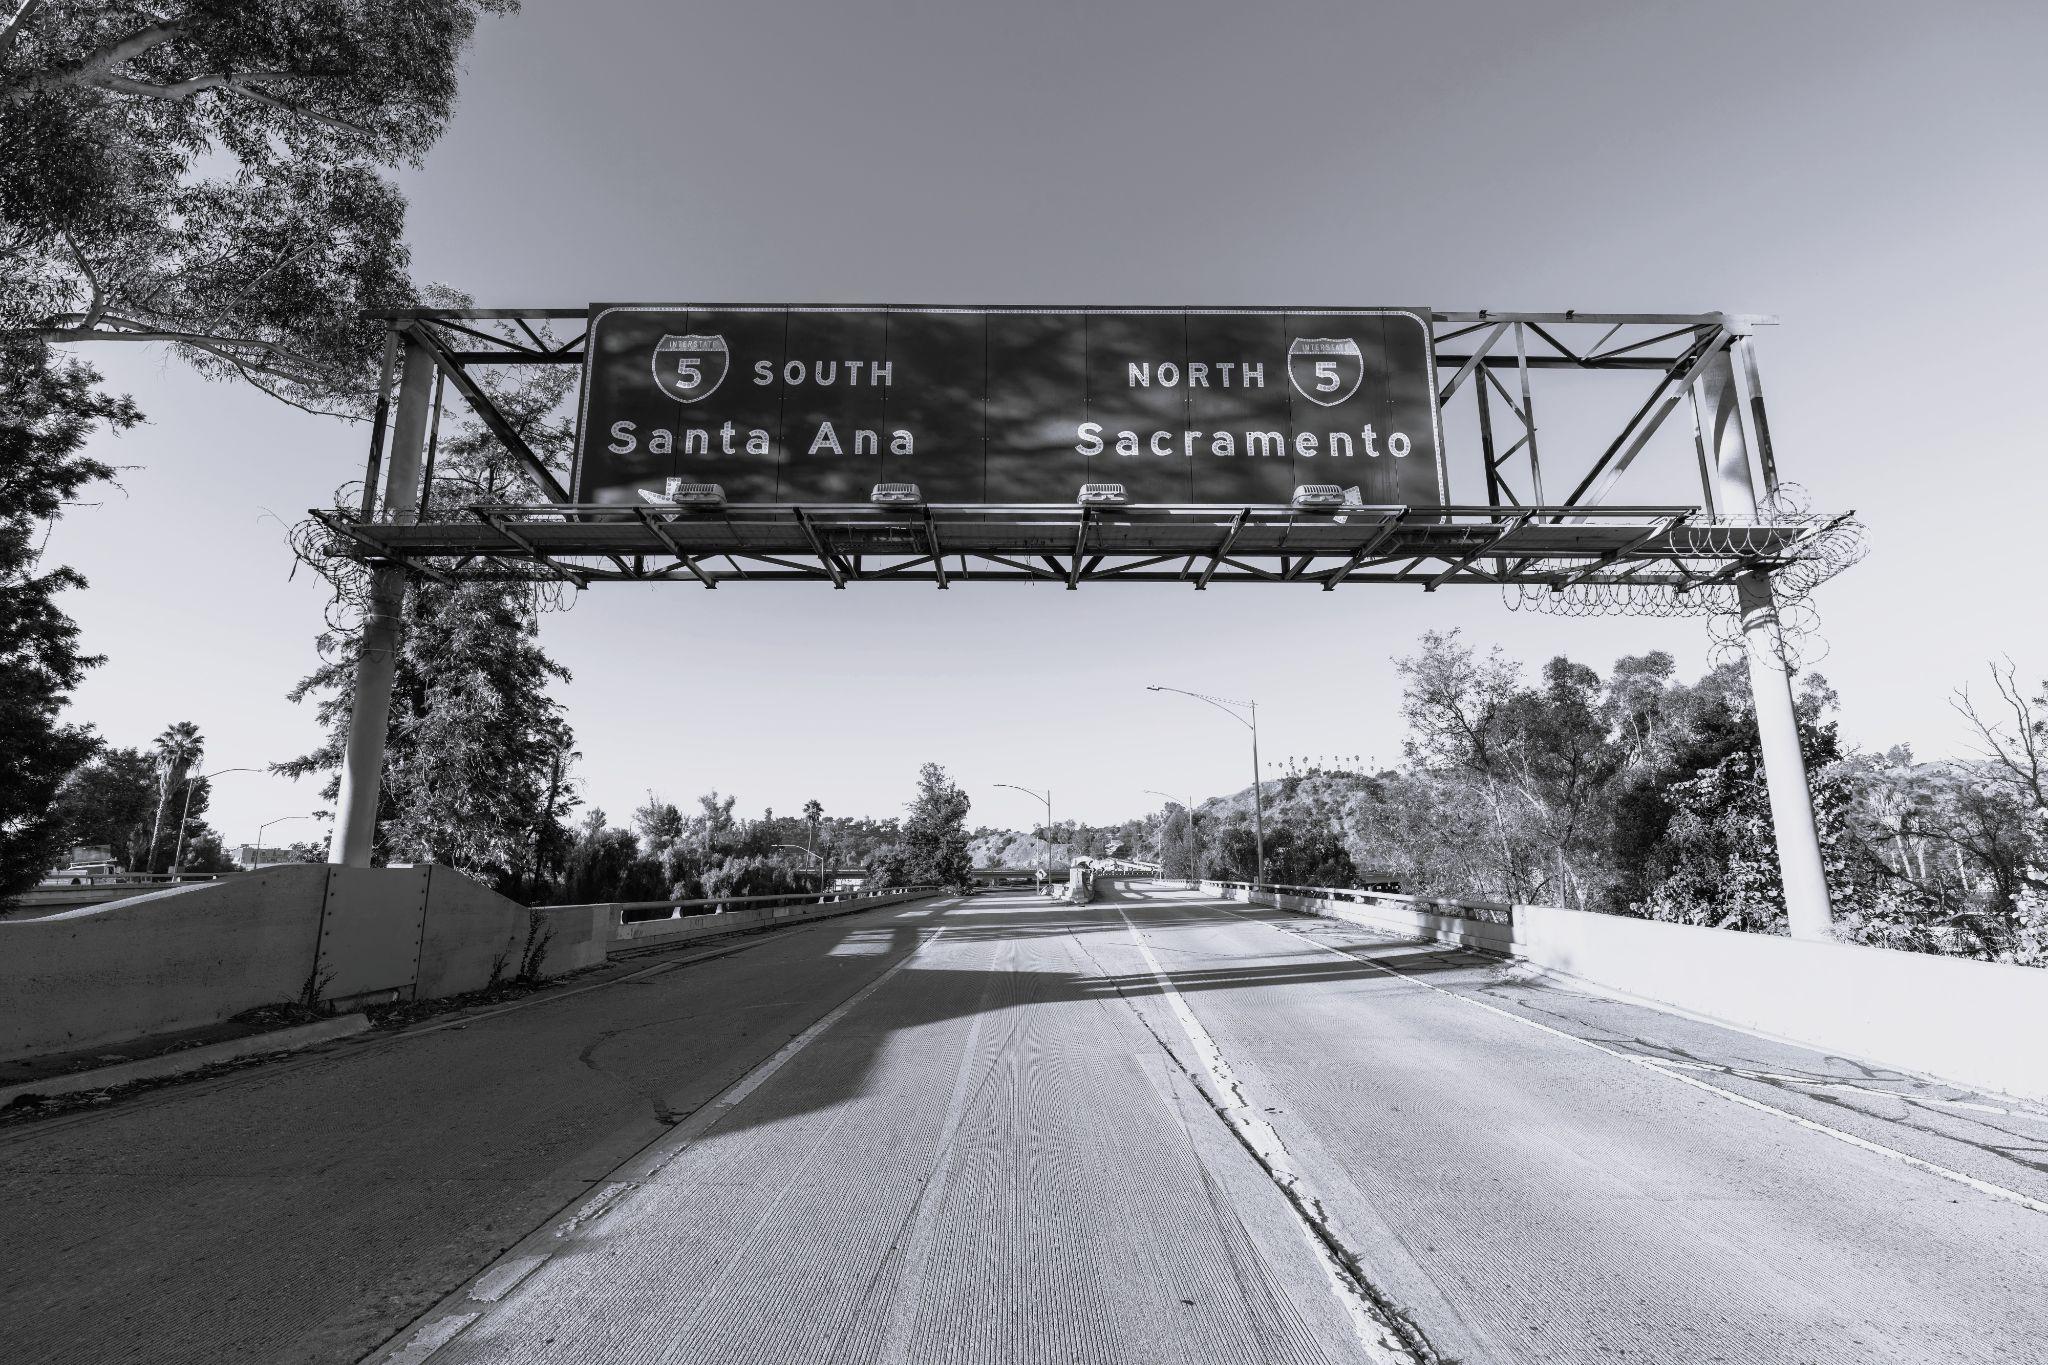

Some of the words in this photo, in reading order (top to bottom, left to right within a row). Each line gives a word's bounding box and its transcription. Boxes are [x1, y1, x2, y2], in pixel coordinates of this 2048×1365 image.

[675, 358, 702, 389] 5
[753, 360, 893, 386] SOUTH
[1128, 362, 1264, 388] NORTH
[1315, 361, 1341, 392] 5
[607, 420, 770, 454] Santa
[808, 421, 914, 455] Ana
[1076, 422, 1412, 457] Sacramento
